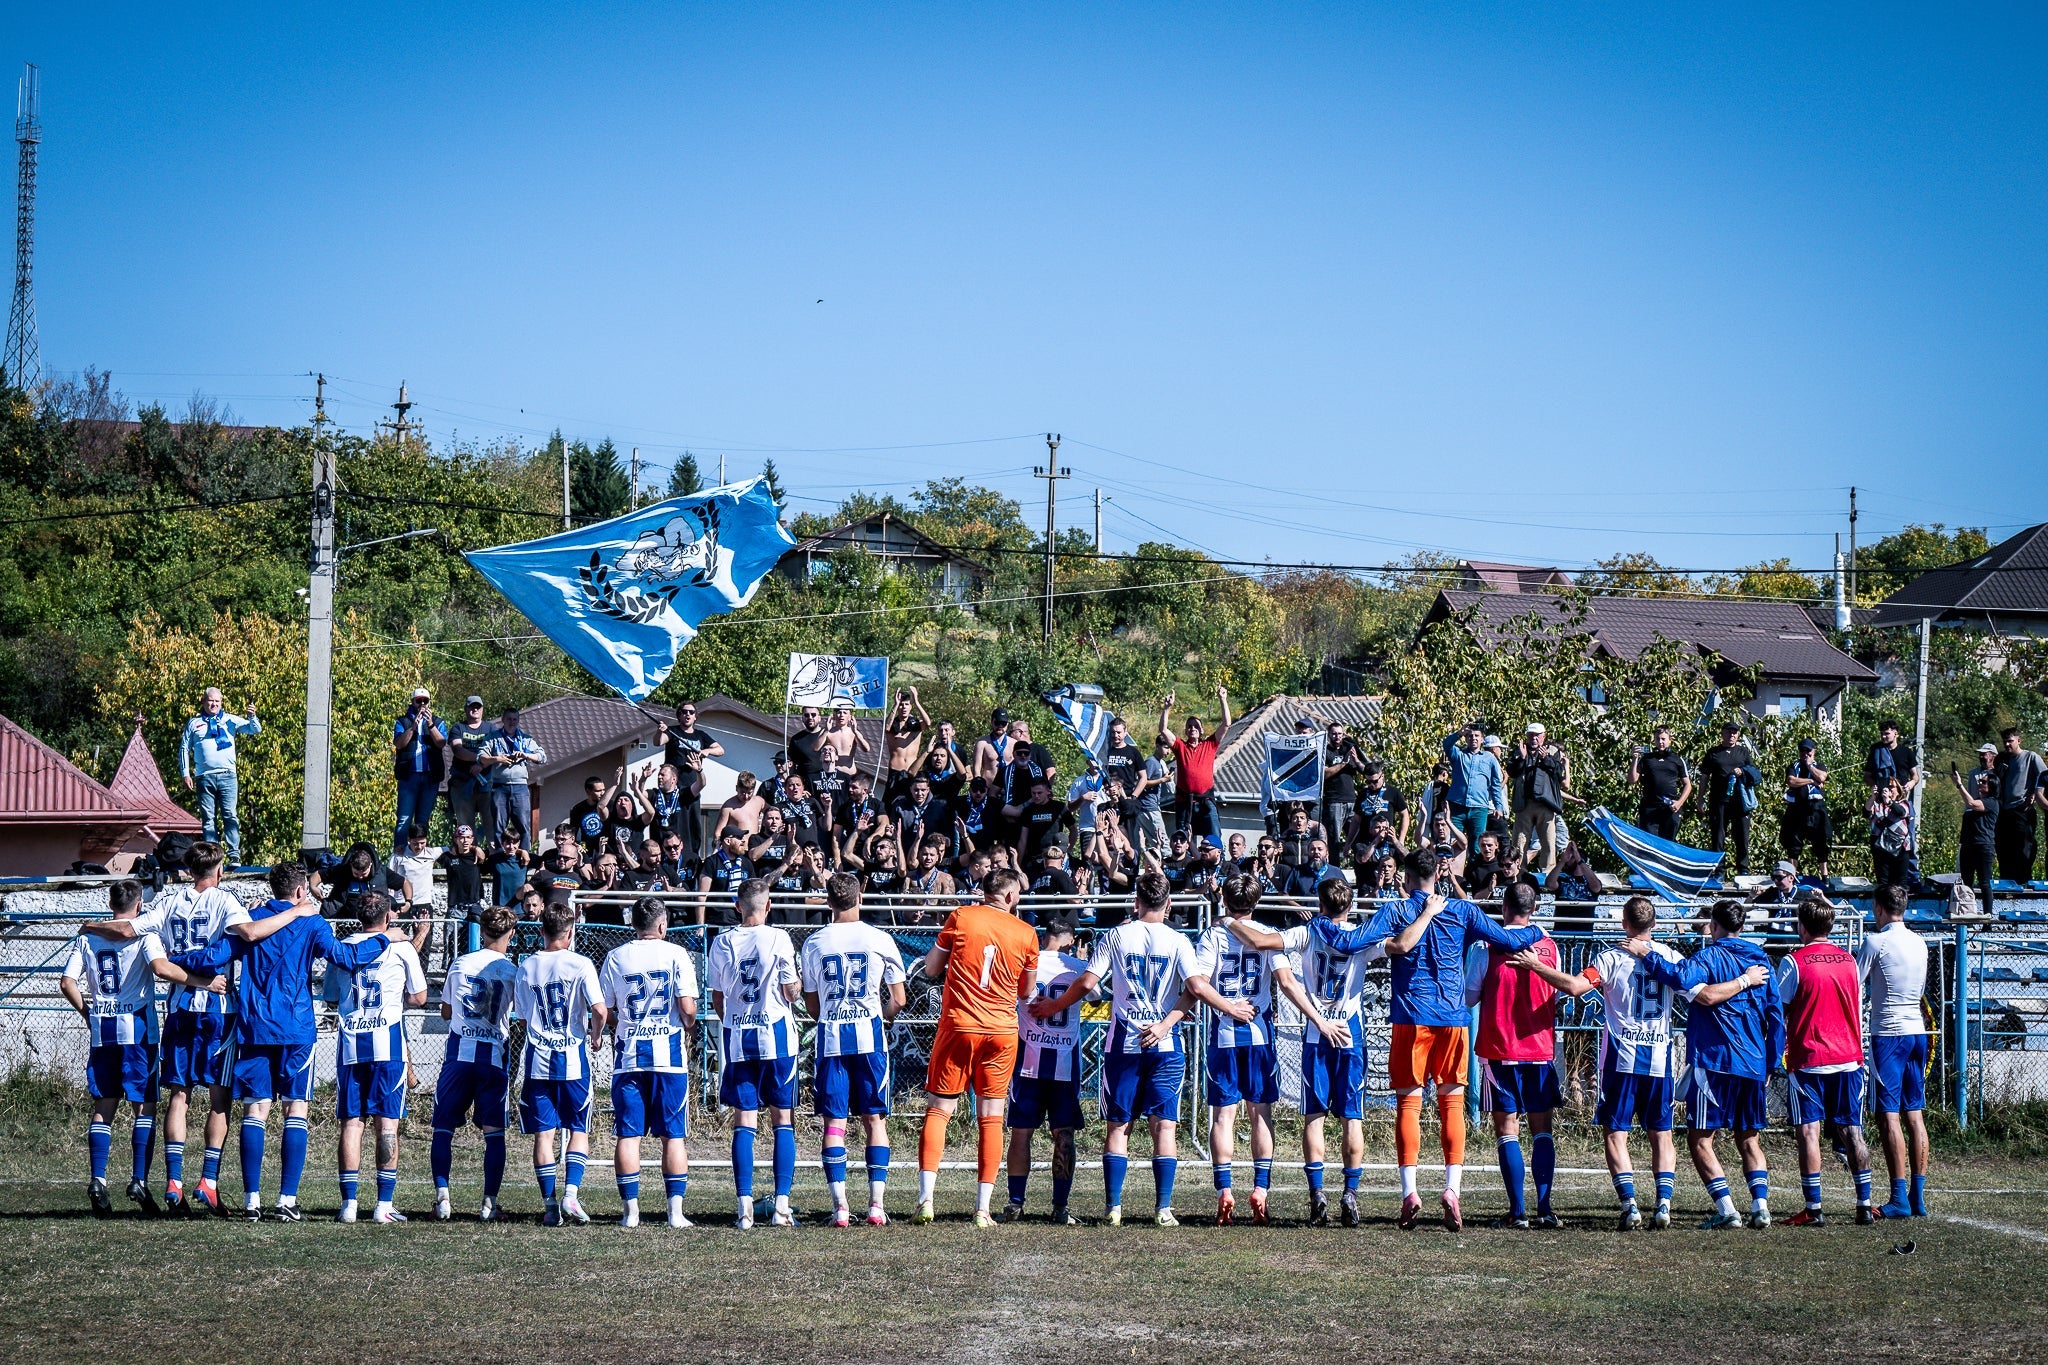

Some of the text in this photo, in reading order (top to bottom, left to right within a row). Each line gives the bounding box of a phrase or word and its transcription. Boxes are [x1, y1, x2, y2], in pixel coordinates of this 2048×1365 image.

[169, 916, 210, 955] 85
[1803, 953, 1852, 965] Kappa
[97, 948, 121, 995] 8
[351, 961, 383, 1009] 15
[738, 957, 761, 1004] 5
[820, 952, 869, 1001] 93
[980, 944, 998, 991] 1
[1124, 953, 1169, 1003] 97
[1217, 951, 1263, 999] 28
[462, 974, 504, 1025] 21
[529, 981, 569, 1032] 18
[623, 969, 671, 1022] 23
[1633, 972, 1664, 1021] 19
[1026, 1029, 1072, 1047] ForIași.ro
